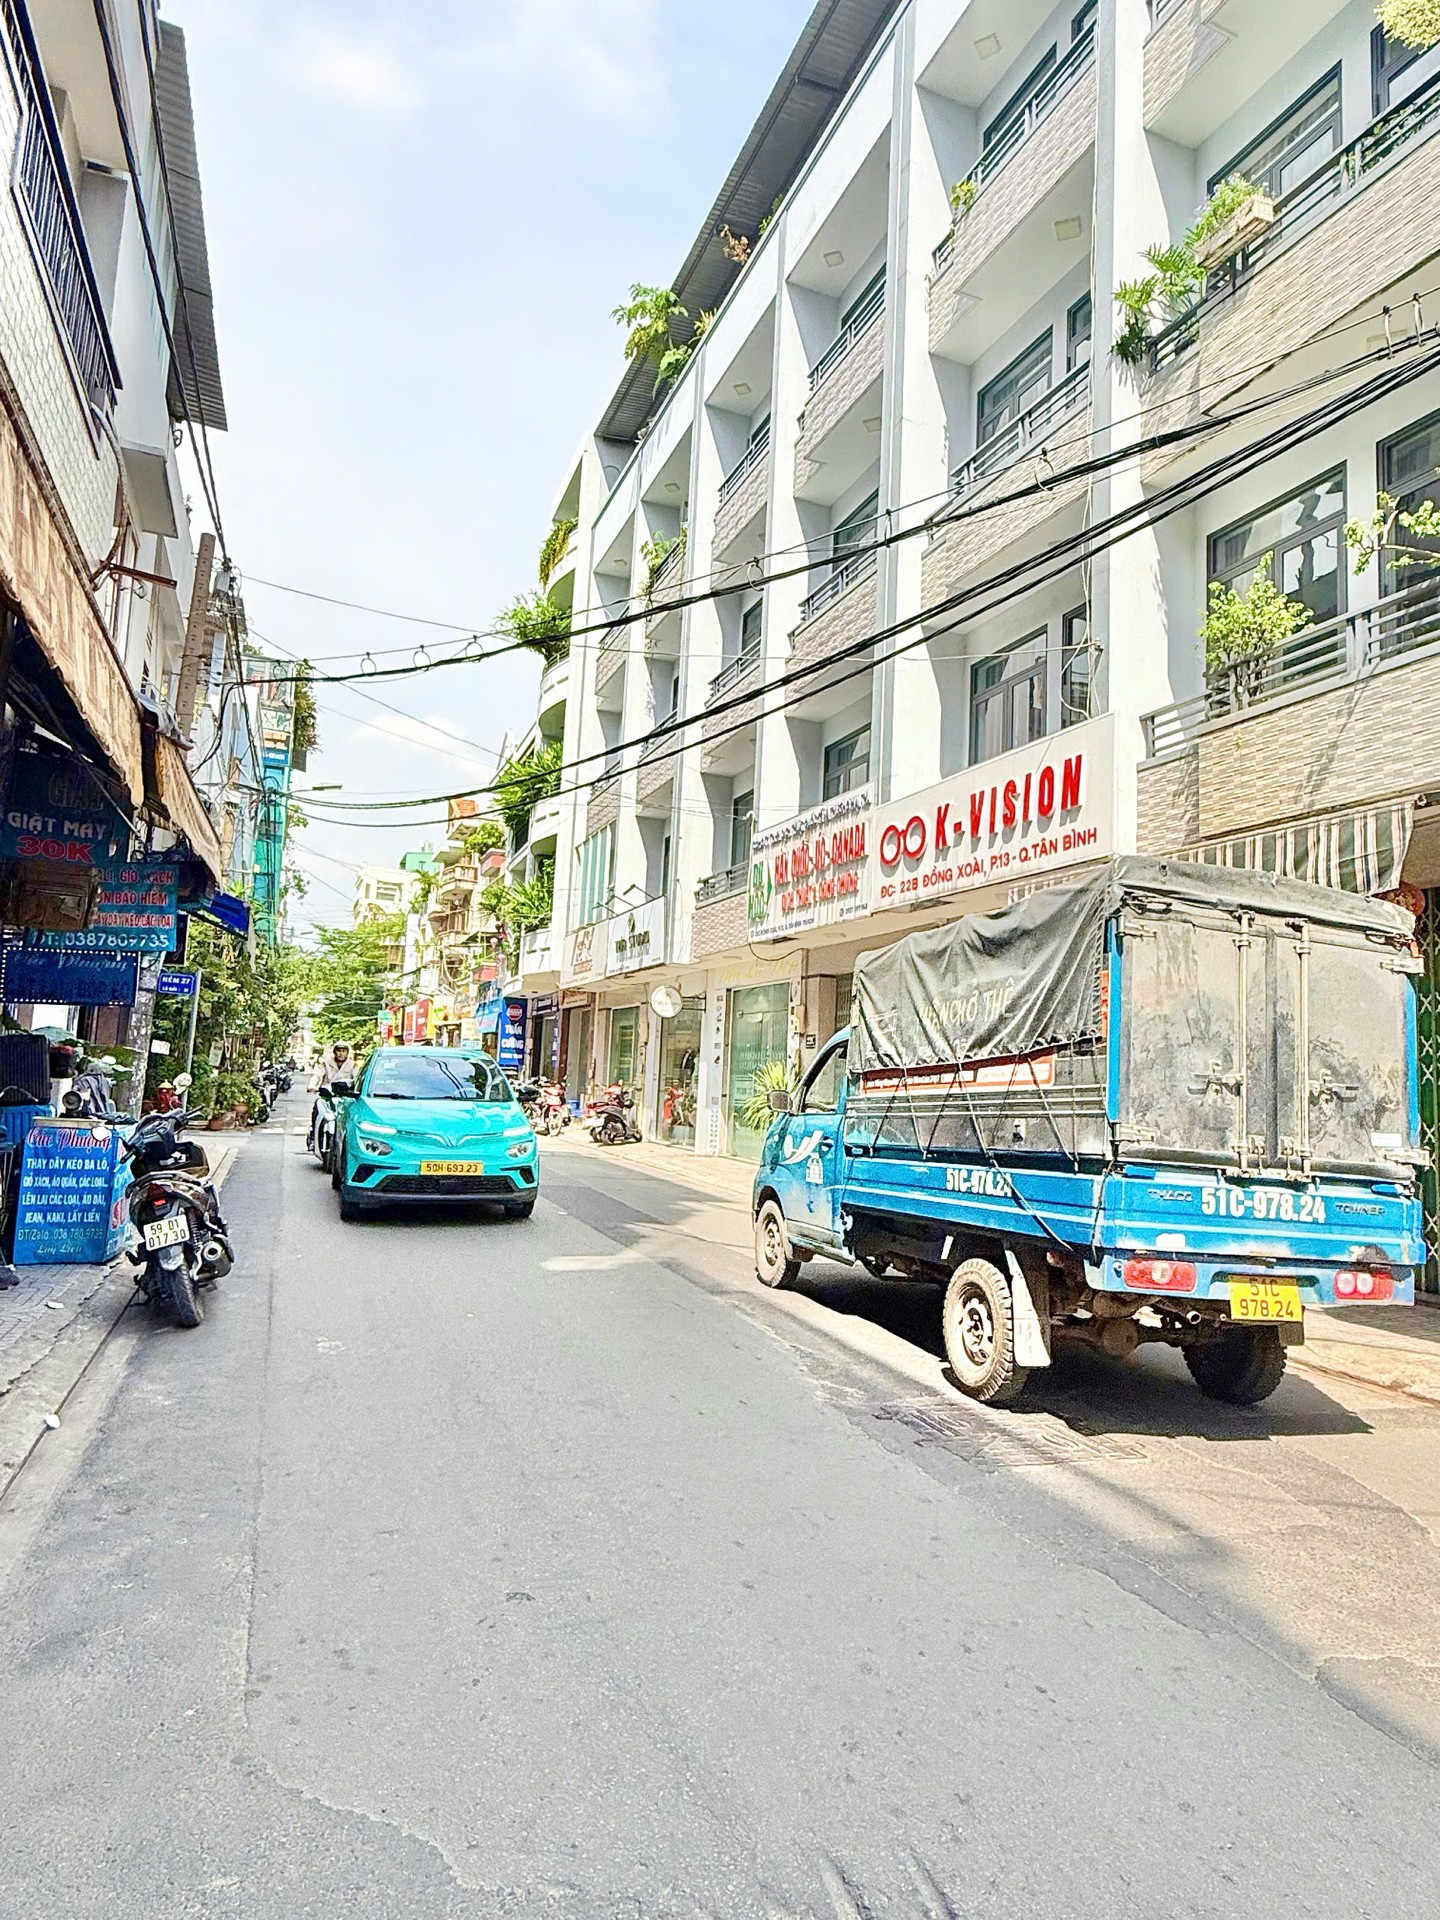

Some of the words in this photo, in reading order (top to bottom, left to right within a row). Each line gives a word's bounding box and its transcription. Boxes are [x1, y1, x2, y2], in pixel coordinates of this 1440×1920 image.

[934, 753, 1083, 851] K-VISION
[16, 834, 96, 865] 30K
[831, 821, 866, 866] CANADA
[880, 884, 897, 899] ĐC:
[899, 877, 919, 894] 22B
[922, 866, 954, 889] ĐỒNG
[956, 857, 987, 878] XOÀI,
[1062, 827, 1098, 852] BÌNH
[26, 1158, 47, 1170] THAY
[49, 1156, 66, 1170] DÂY
[66, 1157, 83, 1170] KÉO
[84, 1159, 96, 1170] BA
[97, 1157, 110, 1172] LÔ,
[24, 1212, 45, 1225] JEAN,
[46, 1211, 66, 1225] KAKI,
[1201, 1186, 1326, 1225] 51C-978.24
[150, 1223, 163, 1236] 59
[1250, 1278, 1281, 1298] 51C
[1239, 1298, 1295, 1319] 978.24
